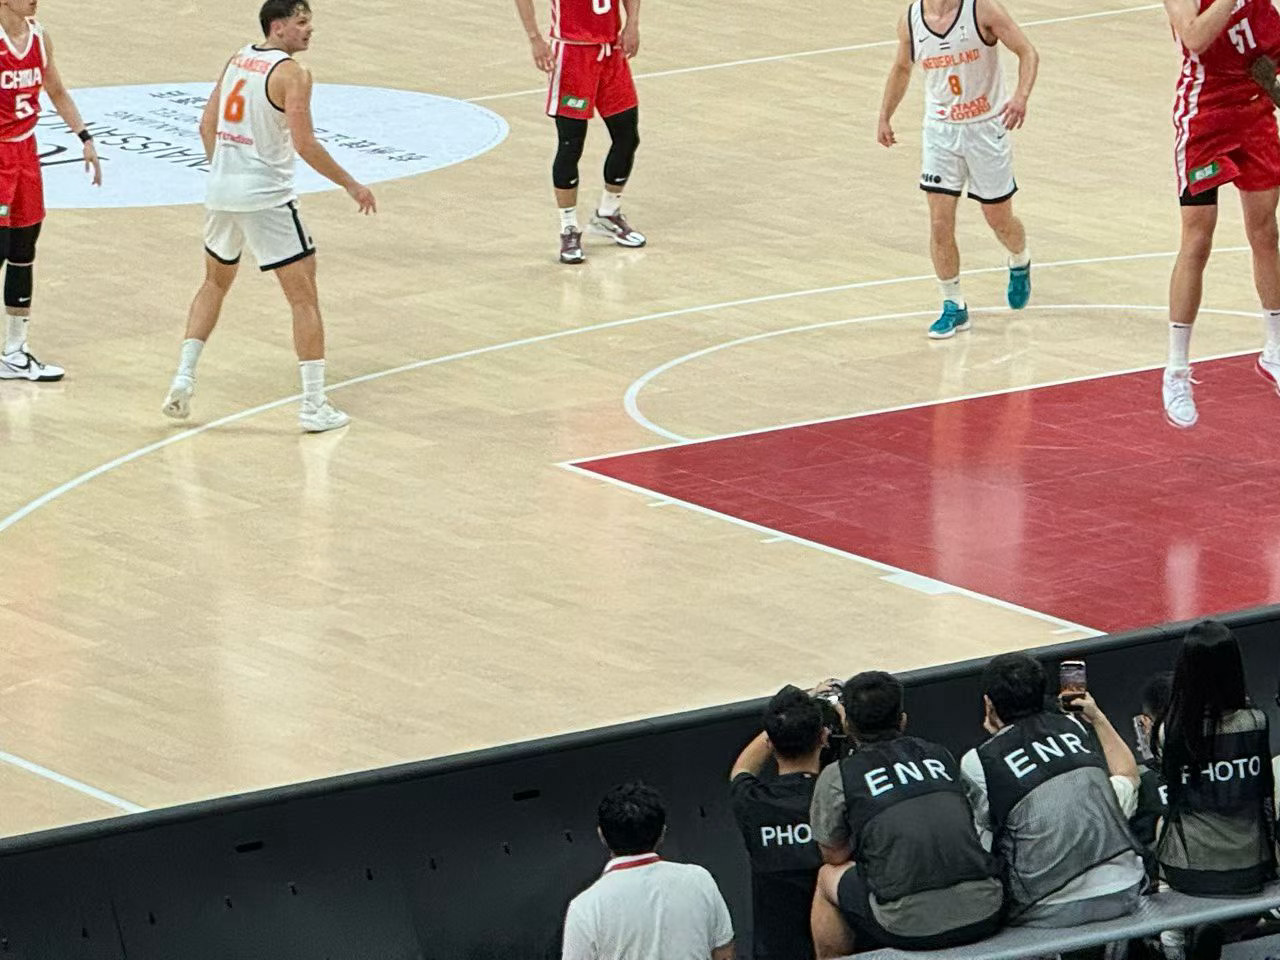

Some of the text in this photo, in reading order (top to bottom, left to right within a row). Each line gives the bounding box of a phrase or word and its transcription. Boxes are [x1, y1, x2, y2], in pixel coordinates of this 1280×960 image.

[1227, 17, 1257, 55] 51
[922, 48, 981, 72] NEDERLAND
[0, 67, 43, 90] CHINA
[947, 73, 962, 97] 8
[15, 93, 35, 119] 5
[223, 78, 247, 124] 6
[1003, 732, 1092, 779] ENR
[864, 758, 954, 798] ENR
[760, 823, 812, 848] PHO
